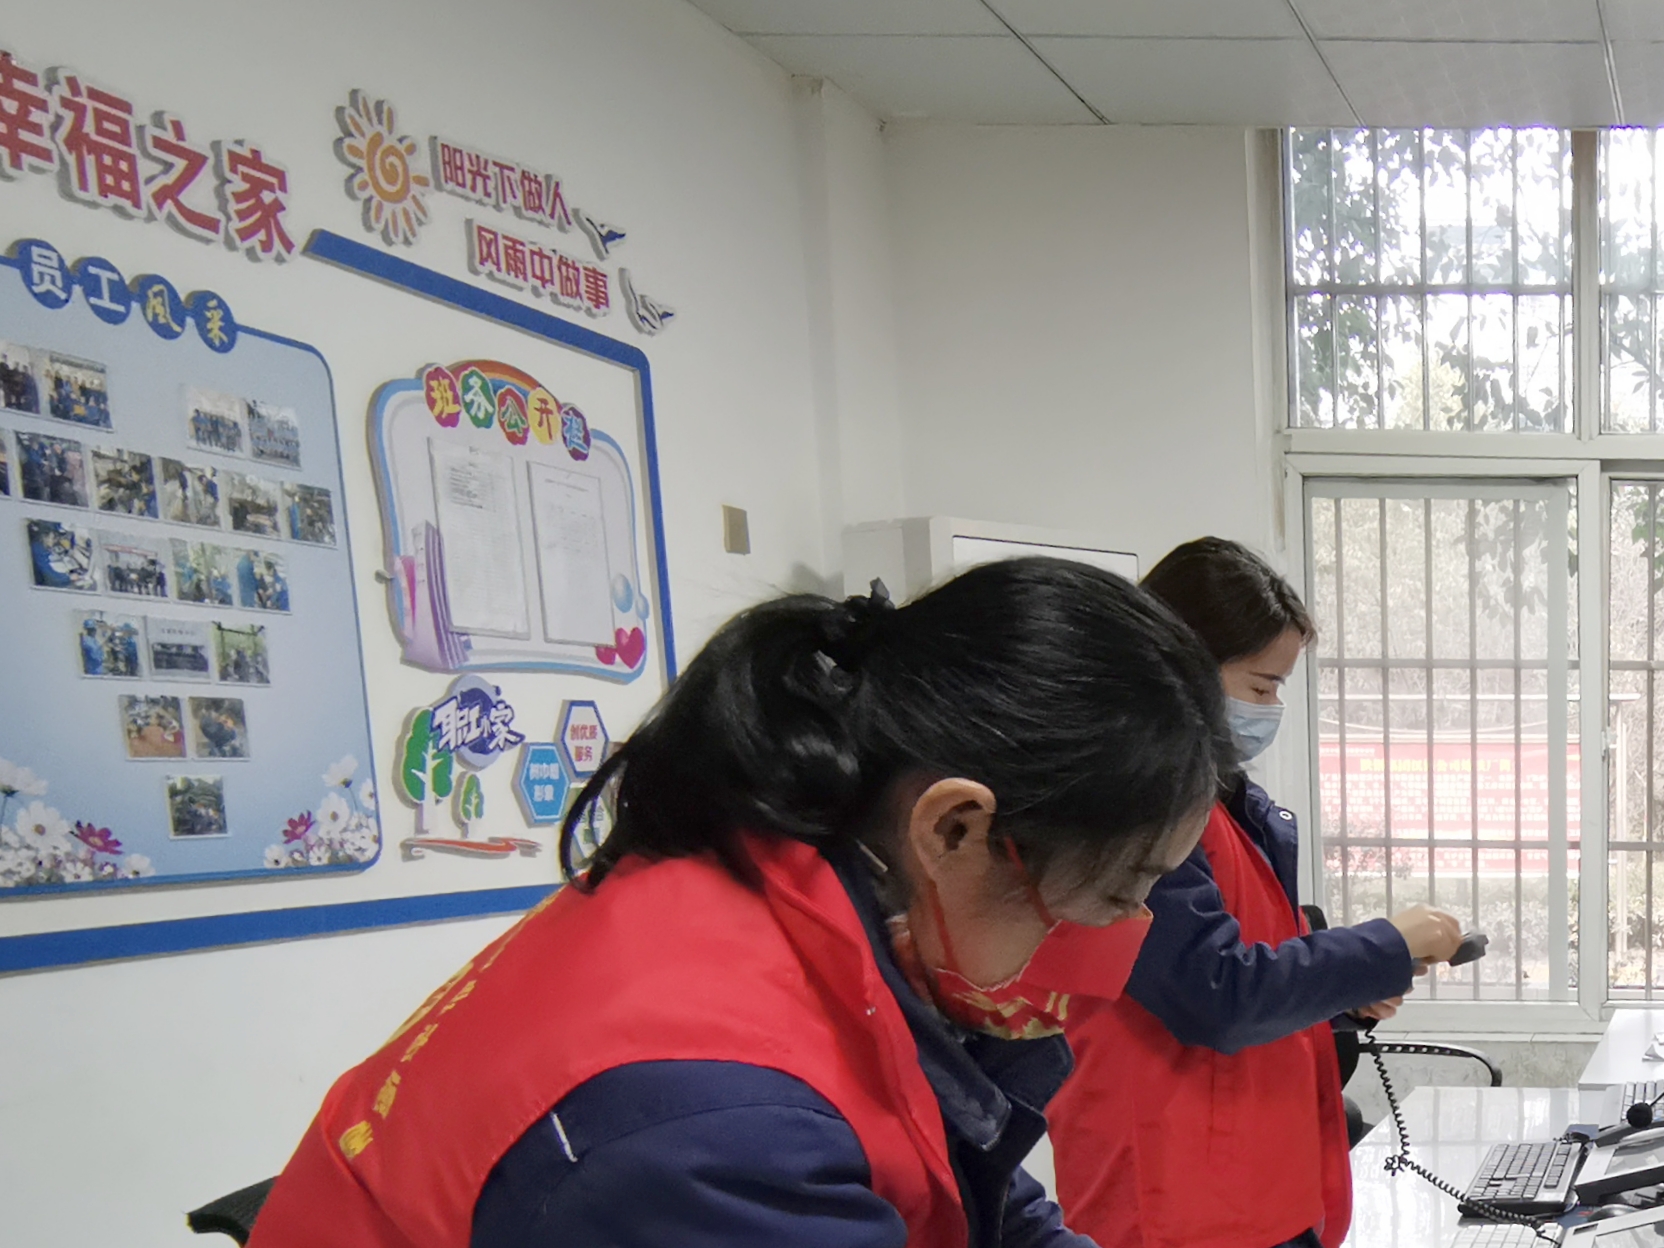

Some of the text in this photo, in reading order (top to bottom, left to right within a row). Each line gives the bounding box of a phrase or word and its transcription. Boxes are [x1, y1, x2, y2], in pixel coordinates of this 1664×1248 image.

[0, 52, 296, 255] 幸福之家
[440, 142, 572, 227] 阳光下做人
[30, 246, 229, 348] 员工风采
[477, 225, 610, 310] 风雨中做事
[428, 375, 589, 453] 班务公开栏
[433, 699, 522, 751] 职工小家
[570, 723, 598, 742] 创优质
[574, 746, 593, 763] 服务
